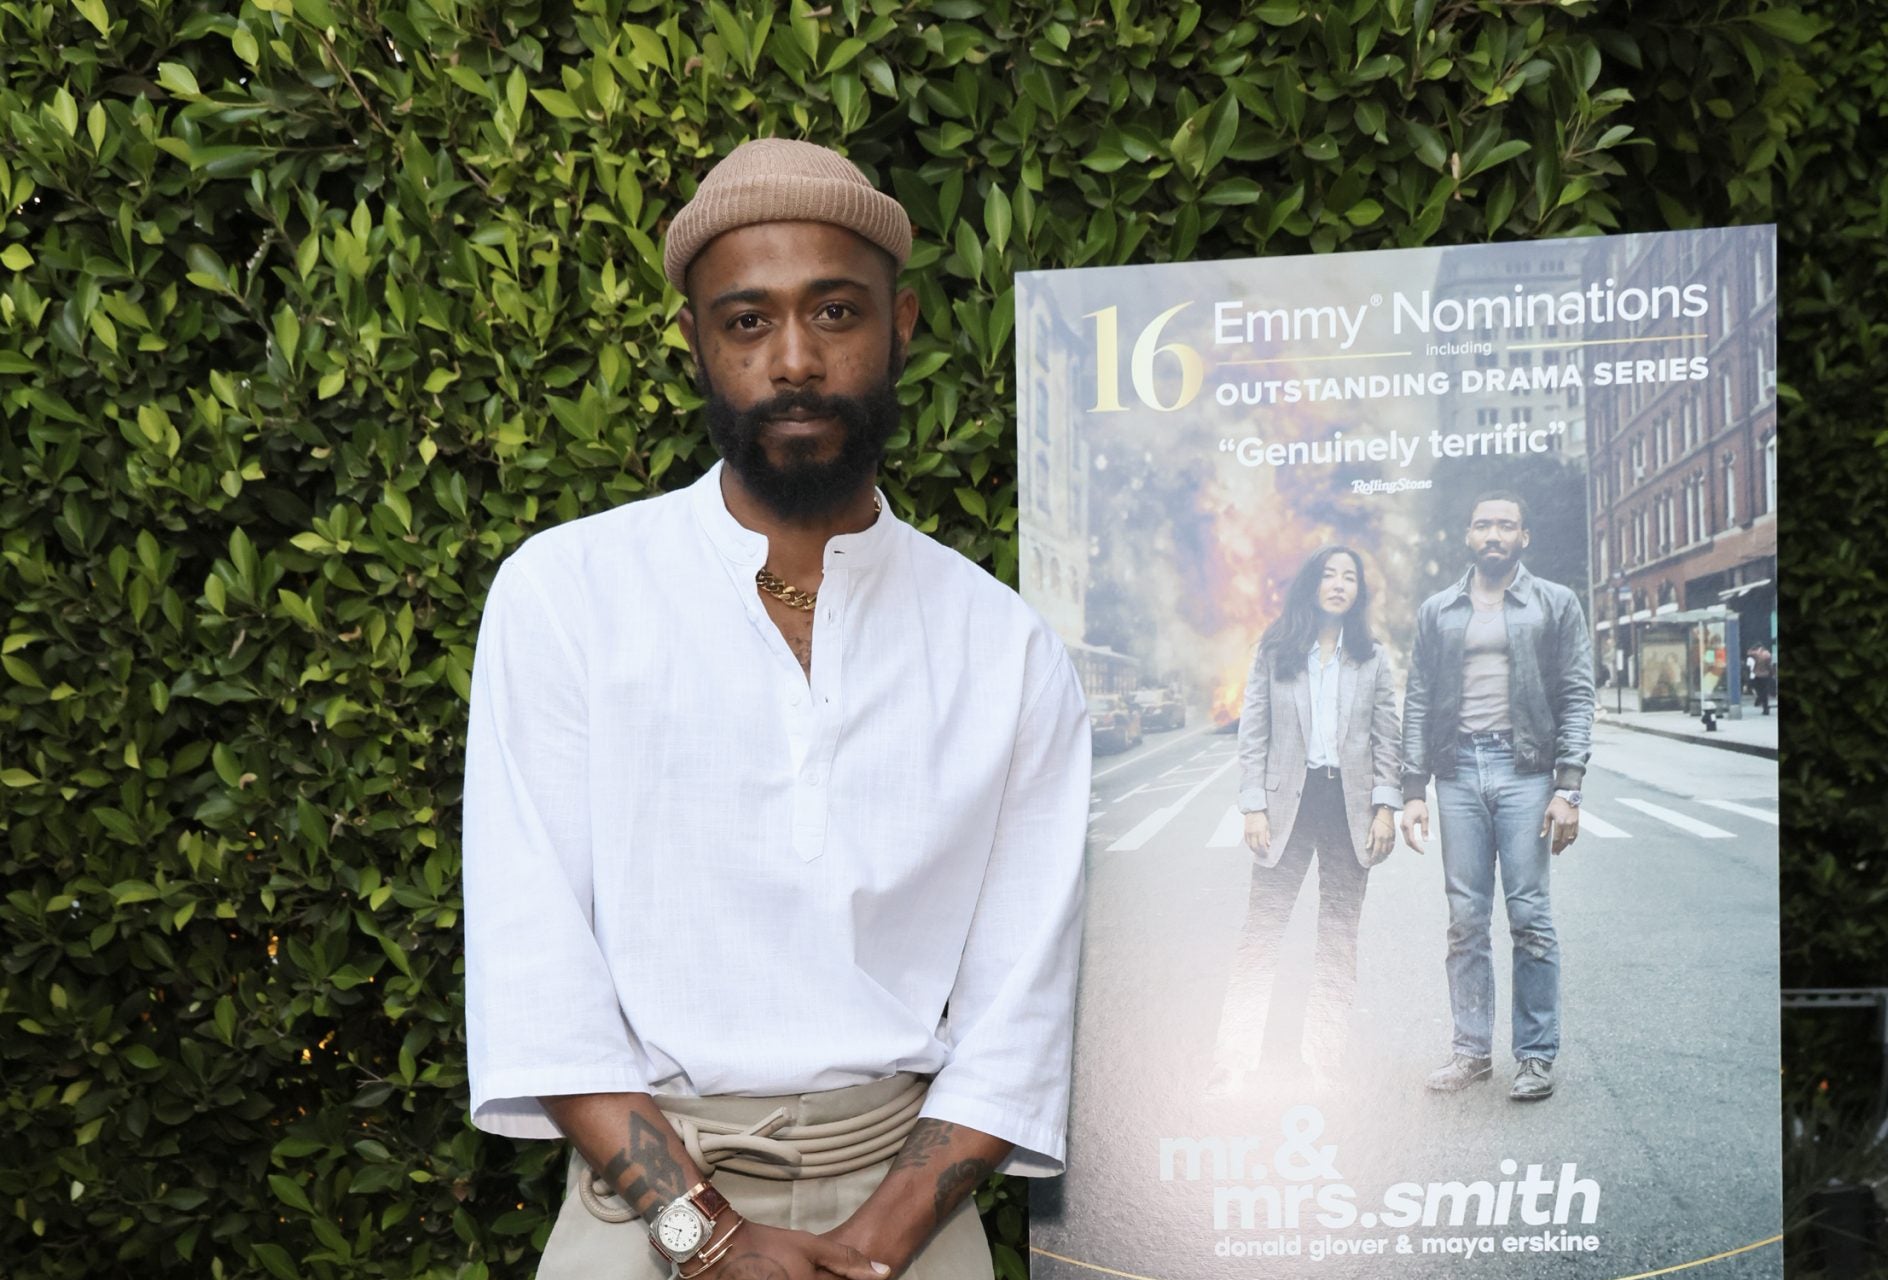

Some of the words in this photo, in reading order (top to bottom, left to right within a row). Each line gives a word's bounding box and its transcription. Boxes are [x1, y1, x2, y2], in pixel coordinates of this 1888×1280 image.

[1393, 278, 1709, 335] Nominations
[1082, 300, 1204, 412] 16
[1425, 340, 1493, 357] including
[1216, 371, 1450, 407] OUTSTANDING
[1462, 364, 1583, 394] DRAMA
[1593, 357, 1709, 386] SERIES
[1214, 1235, 1302, 1257] donald
[1309, 1234, 1389, 1262] glover
[1395, 1234, 1414, 1255] &
[1422, 1235, 1495, 1260] maya
[1502, 1229, 1600, 1252] erskine
